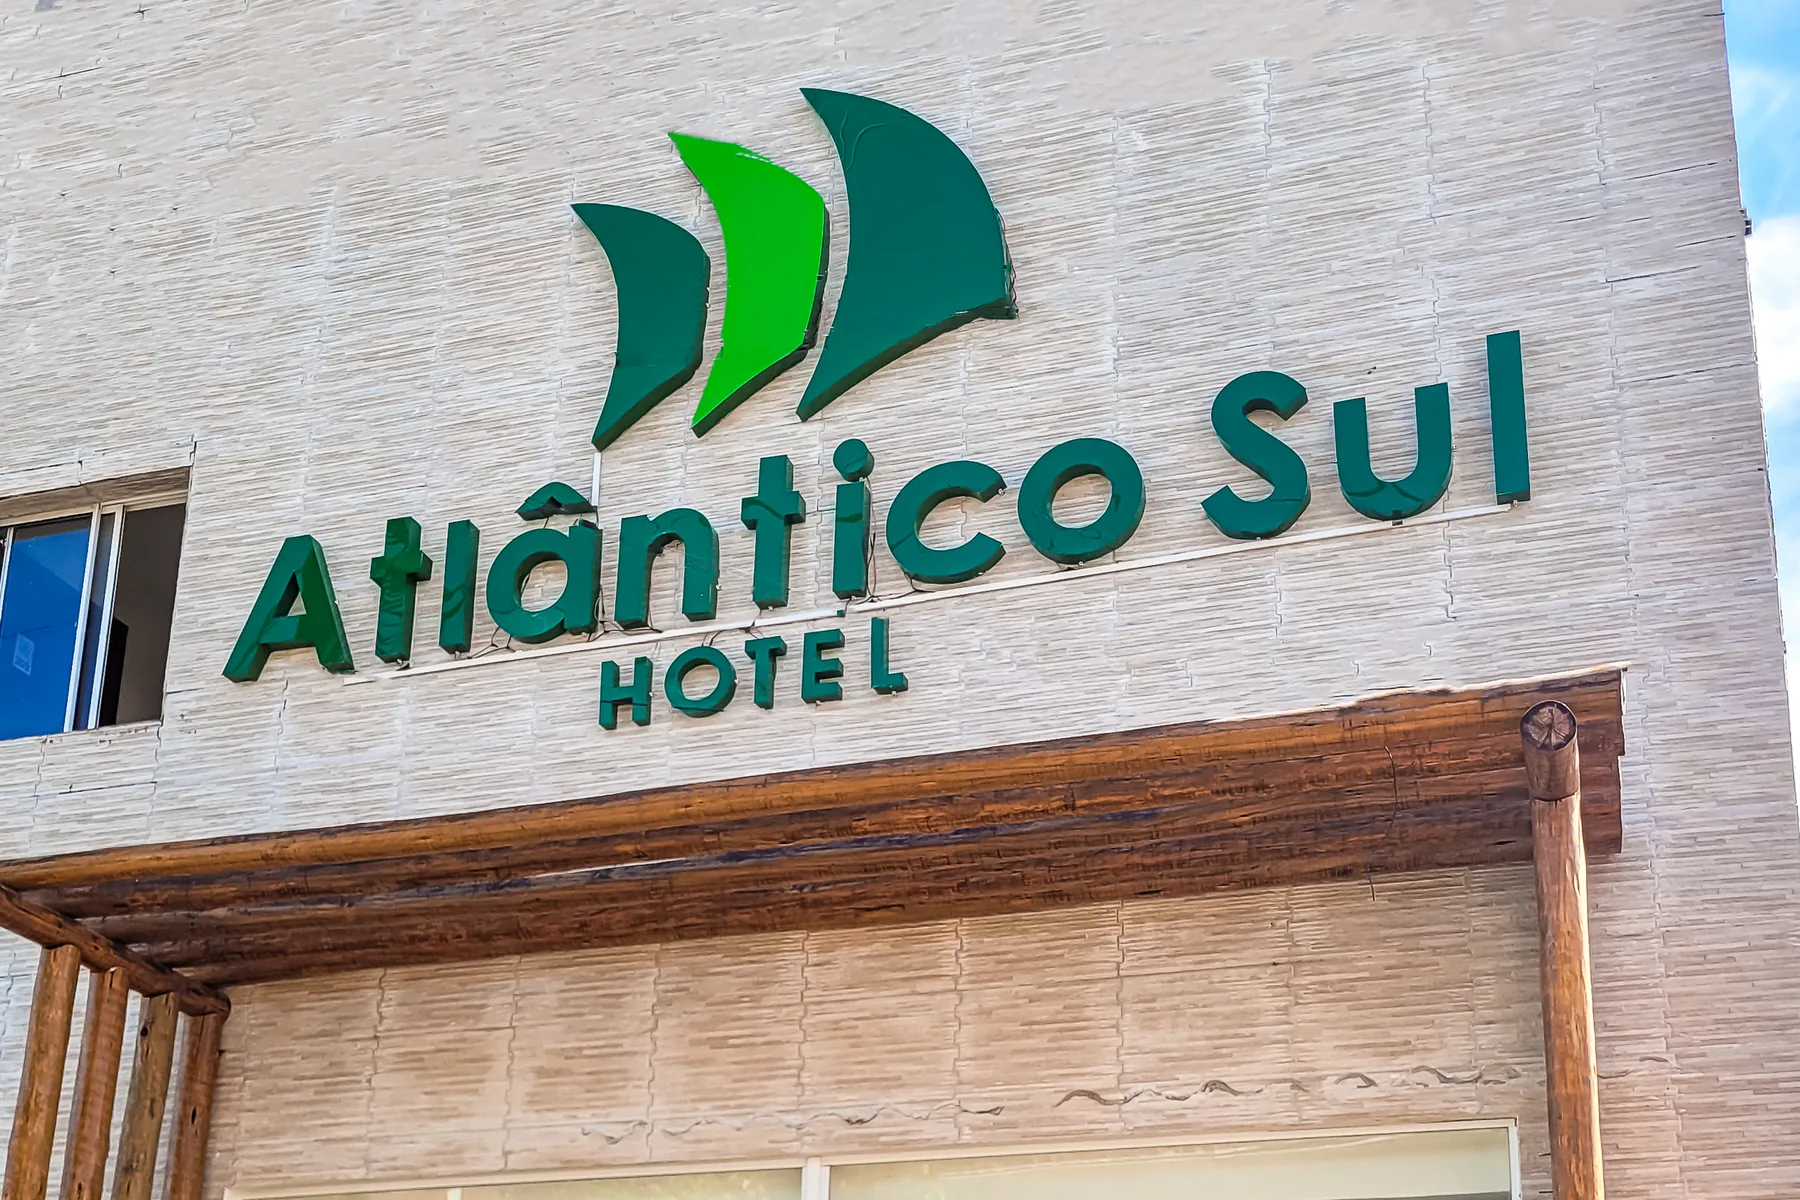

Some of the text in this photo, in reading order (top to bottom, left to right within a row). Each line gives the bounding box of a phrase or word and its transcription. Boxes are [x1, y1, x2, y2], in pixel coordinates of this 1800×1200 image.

[223, 330, 1531, 681] Atlântico Sul
[599, 616, 908, 730] HOTEL
